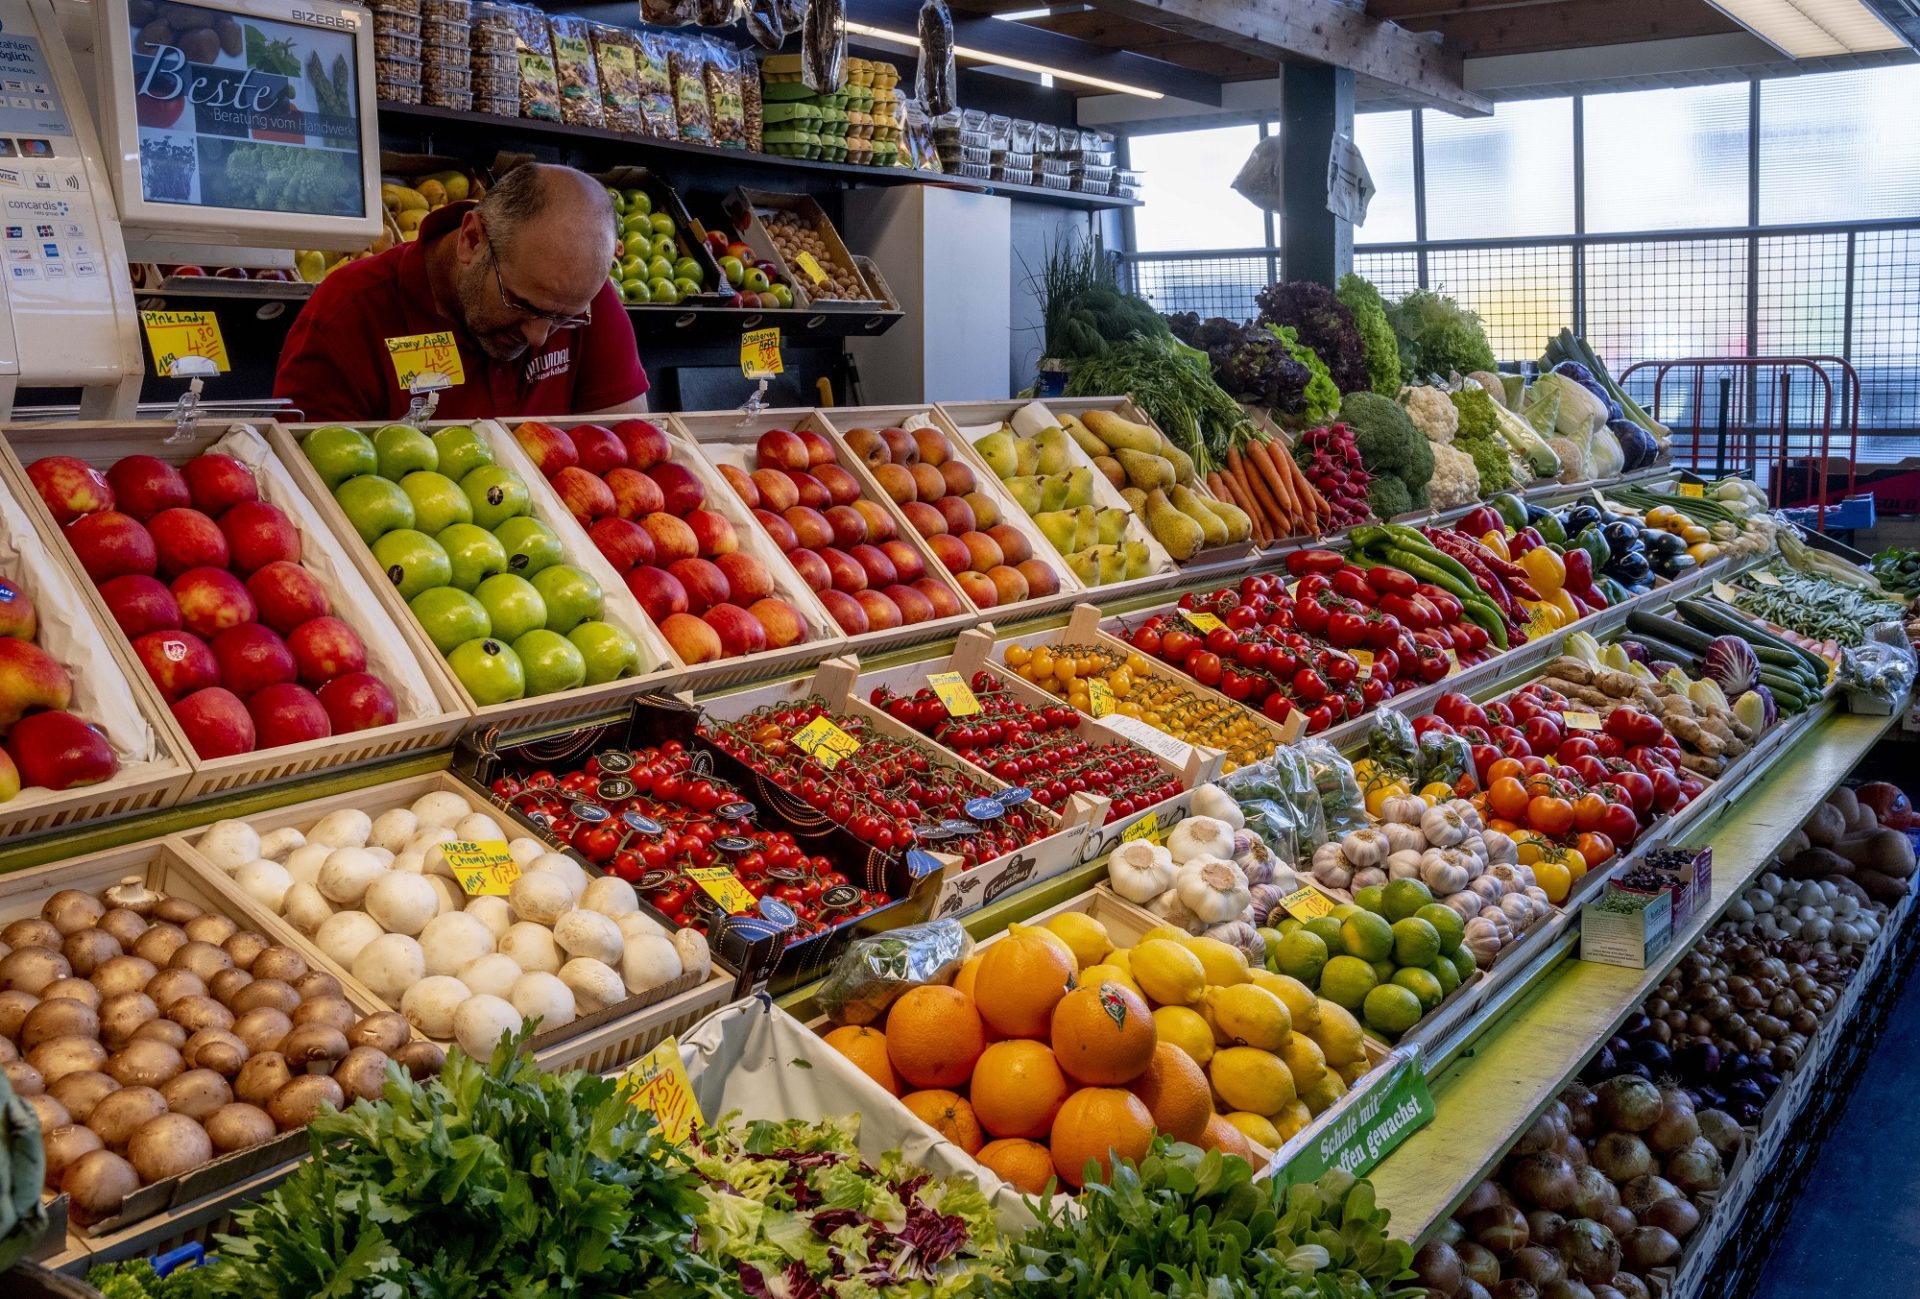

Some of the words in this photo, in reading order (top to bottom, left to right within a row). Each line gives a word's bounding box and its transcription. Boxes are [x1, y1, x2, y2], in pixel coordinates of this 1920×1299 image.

[291, 9, 357, 30] BIZERBA
[138, 41, 279, 112] Beste
[213, 107, 268, 130] Beratung
[271, 117, 297, 131] vom
[299, 119, 356, 137] Handwerk
[8, 200, 58, 212] concardis
[176, 312, 205, 325] Lady
[629, 1054, 659, 1095] Salat
[1320, 1113, 1359, 1164] Schale
[1360, 1094, 1381, 1127] mit
[1366, 1094, 1423, 1160] gewachst
